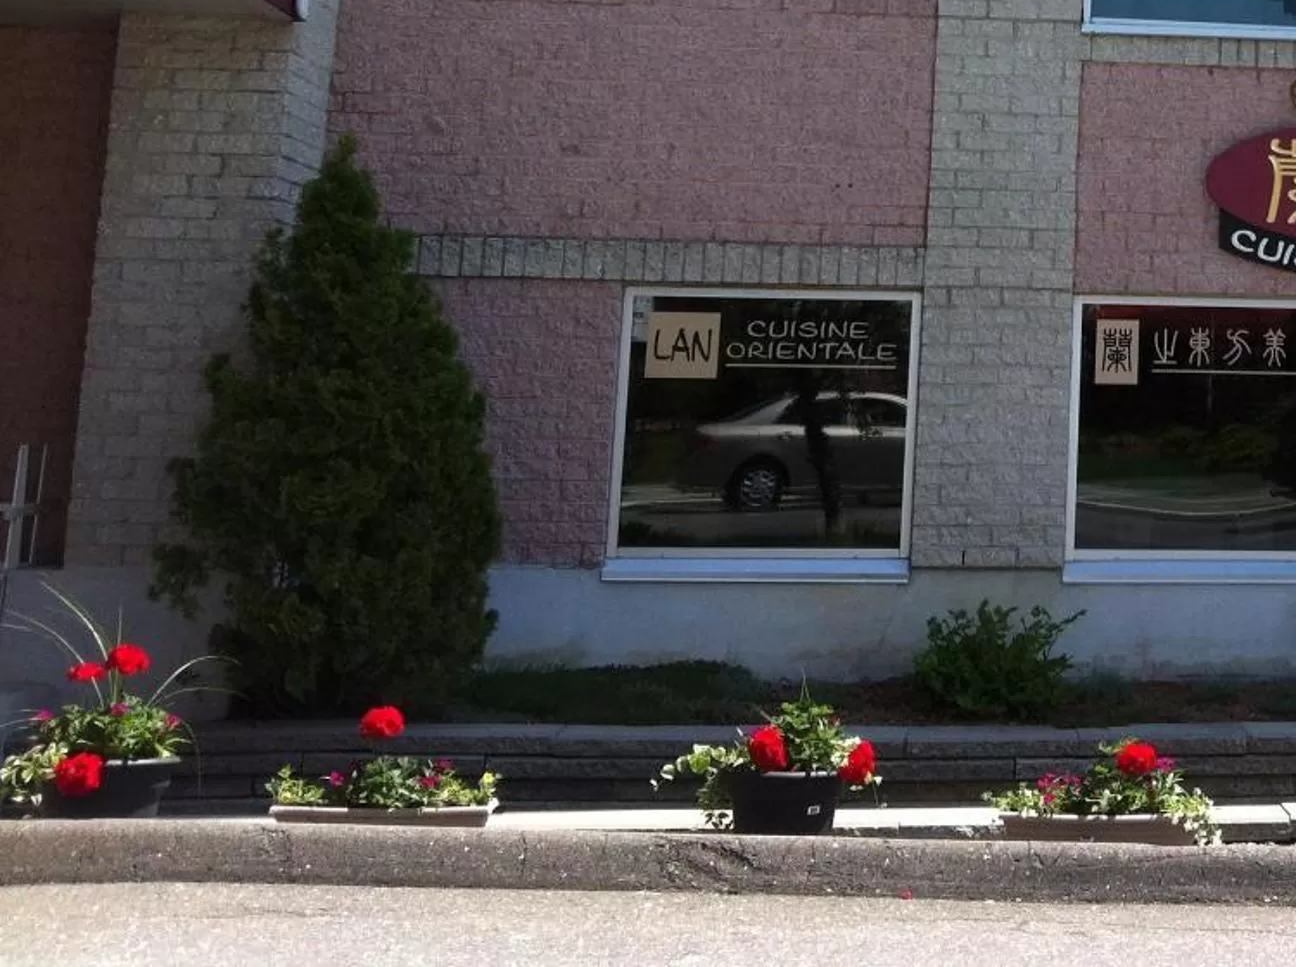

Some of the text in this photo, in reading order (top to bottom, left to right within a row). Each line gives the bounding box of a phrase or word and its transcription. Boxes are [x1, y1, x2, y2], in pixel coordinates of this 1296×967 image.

[747, 320, 869, 339] CUISINE
[653, 328, 712, 363] LAN
[726, 342, 897, 361] ORIENTALE
